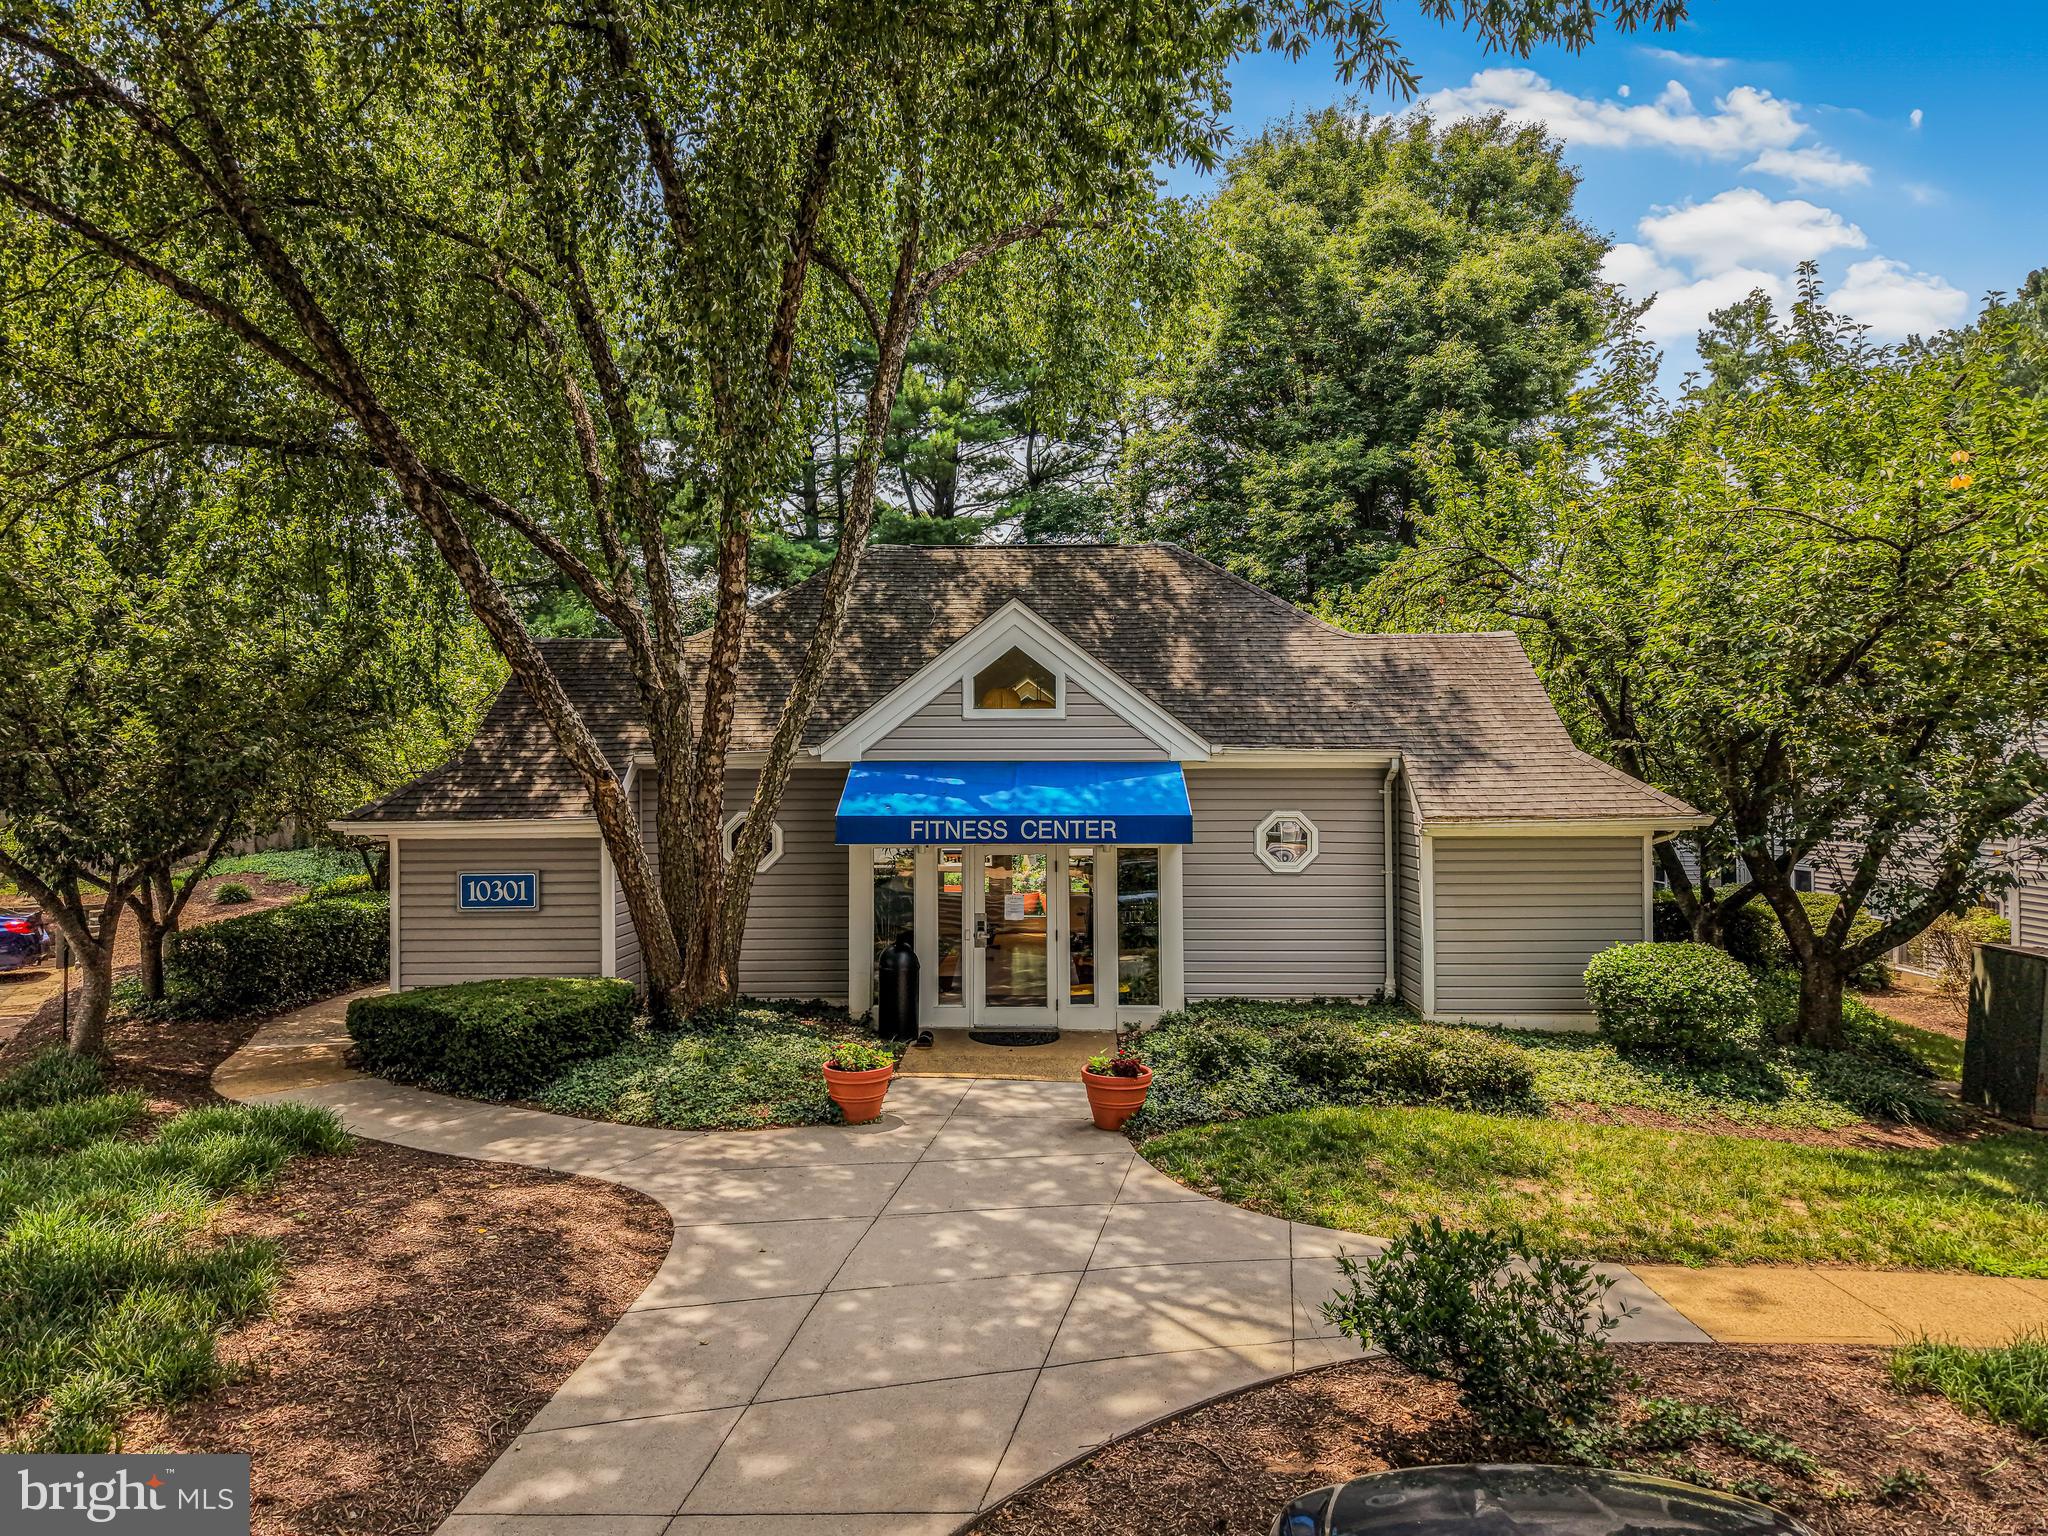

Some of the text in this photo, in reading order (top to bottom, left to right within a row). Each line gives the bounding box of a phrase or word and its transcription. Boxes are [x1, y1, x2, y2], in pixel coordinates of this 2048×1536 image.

[910, 820, 1117, 840] FITNESS CENTER
[467, 880, 528, 902] 10301
